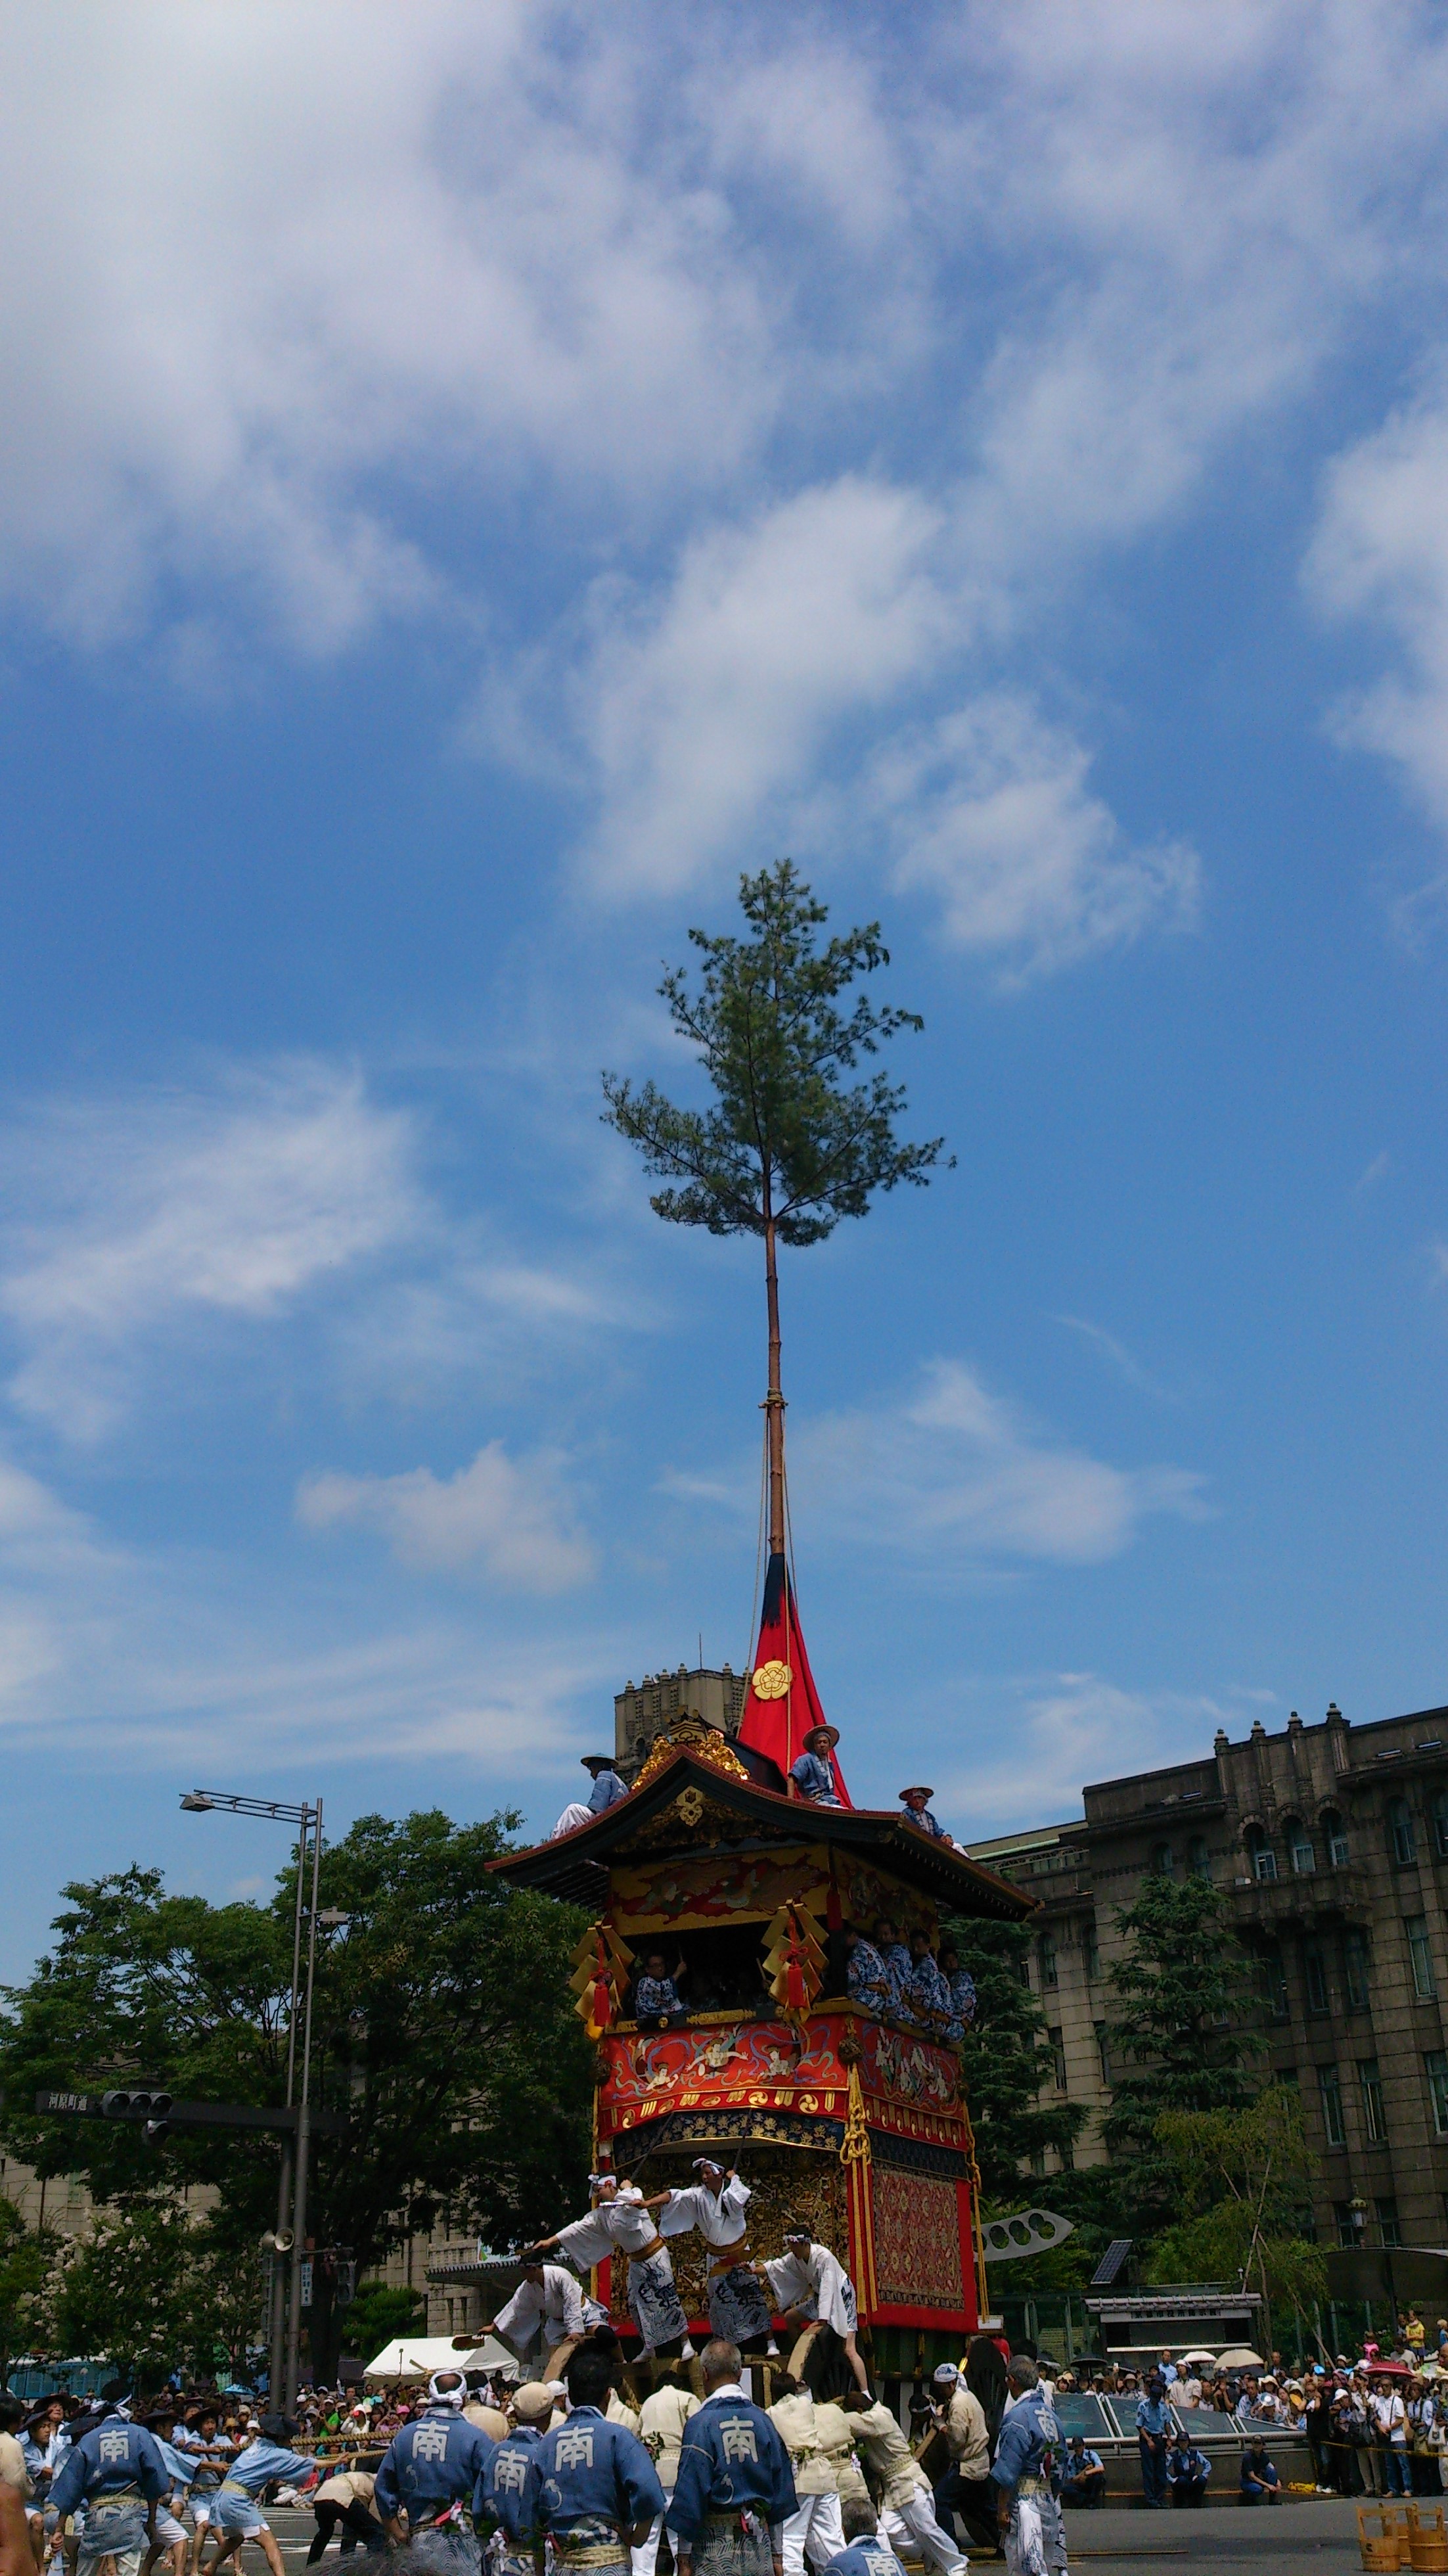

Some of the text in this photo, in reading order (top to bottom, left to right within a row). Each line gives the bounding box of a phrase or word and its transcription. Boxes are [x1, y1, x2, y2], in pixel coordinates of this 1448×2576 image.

[99, 2429, 129, 2464] 南
[412, 2420, 450, 2462] 南
[719, 2415, 759, 2465] 南
[1033, 2406, 1059, 2443] 南
[555, 2426, 595, 2472] 南
[494, 2449, 528, 2497] 南
